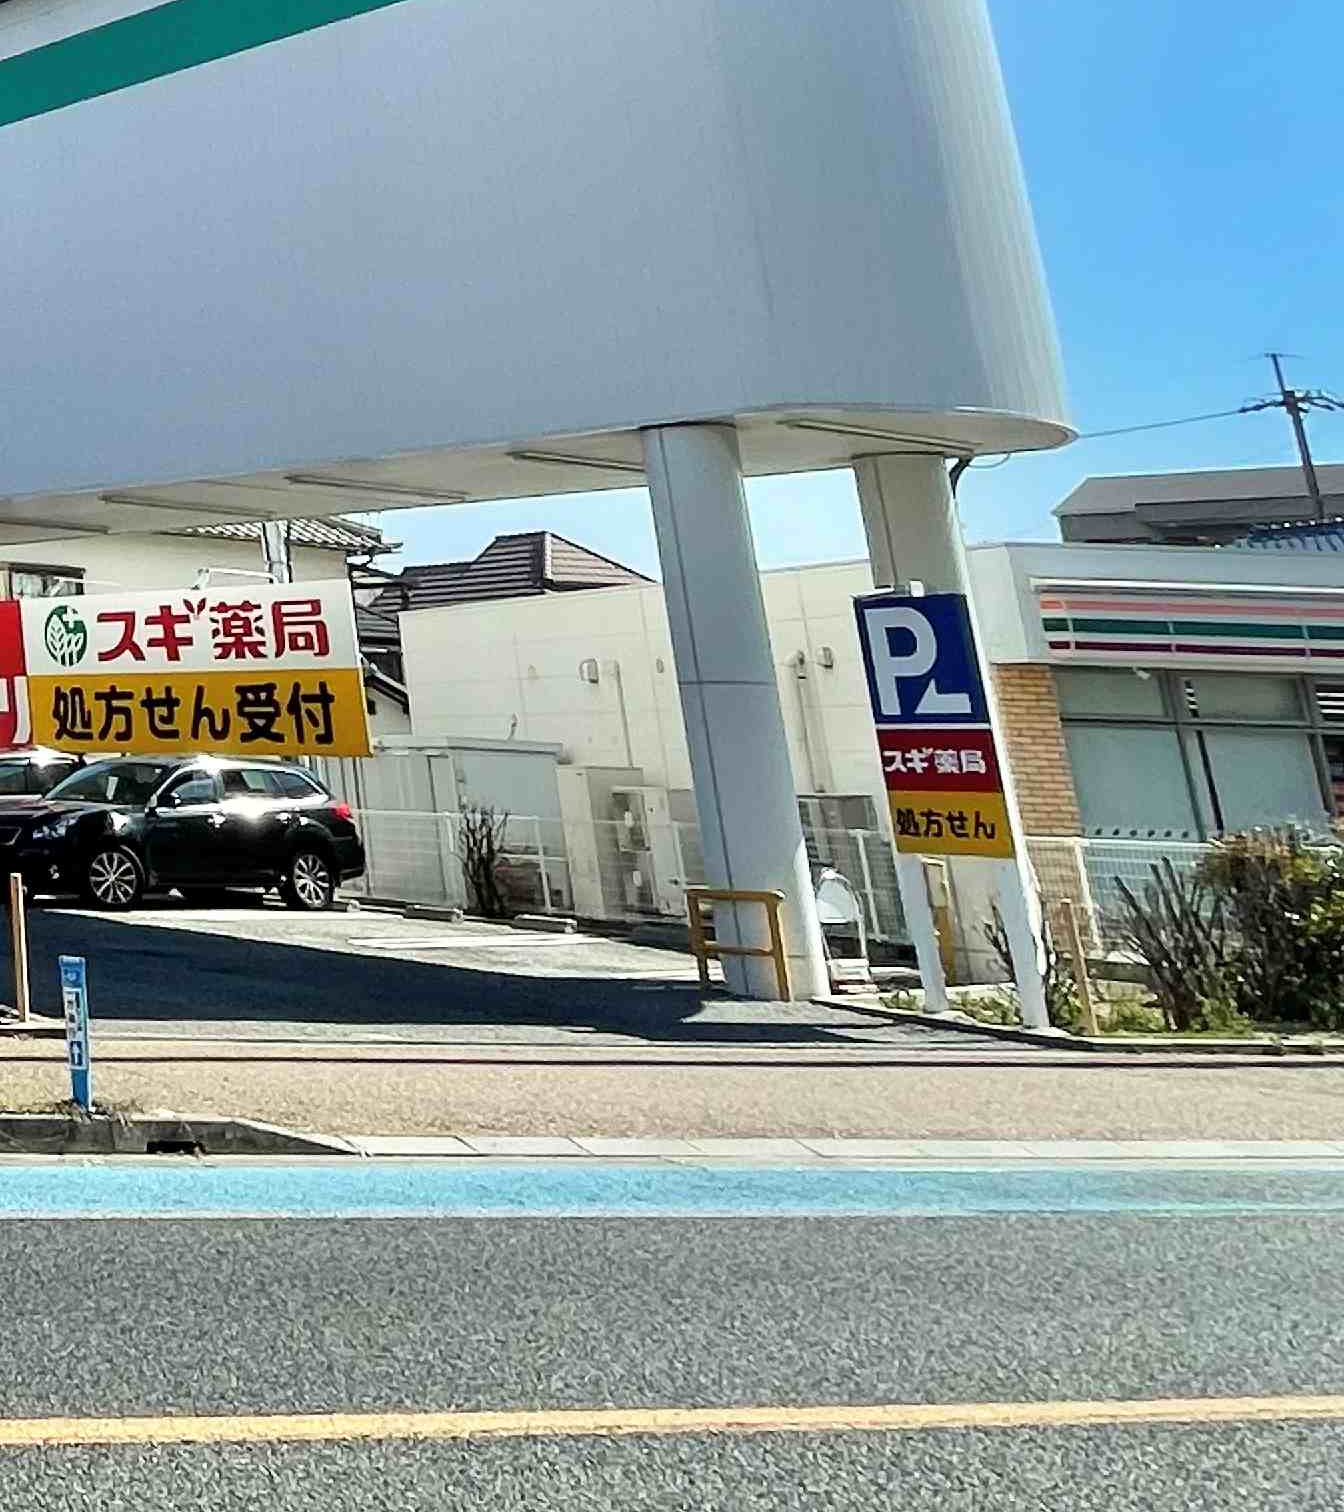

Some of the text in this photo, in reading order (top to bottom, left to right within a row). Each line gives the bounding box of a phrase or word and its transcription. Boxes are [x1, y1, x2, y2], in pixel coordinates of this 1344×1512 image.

[97, 597, 330, 662] スギ薬局
[863, 606, 937, 716] P
[52, 681, 336, 745] 処方せん受付
[882, 747, 987, 774] スギ薬局
[895, 807, 996, 840] 処方せん
